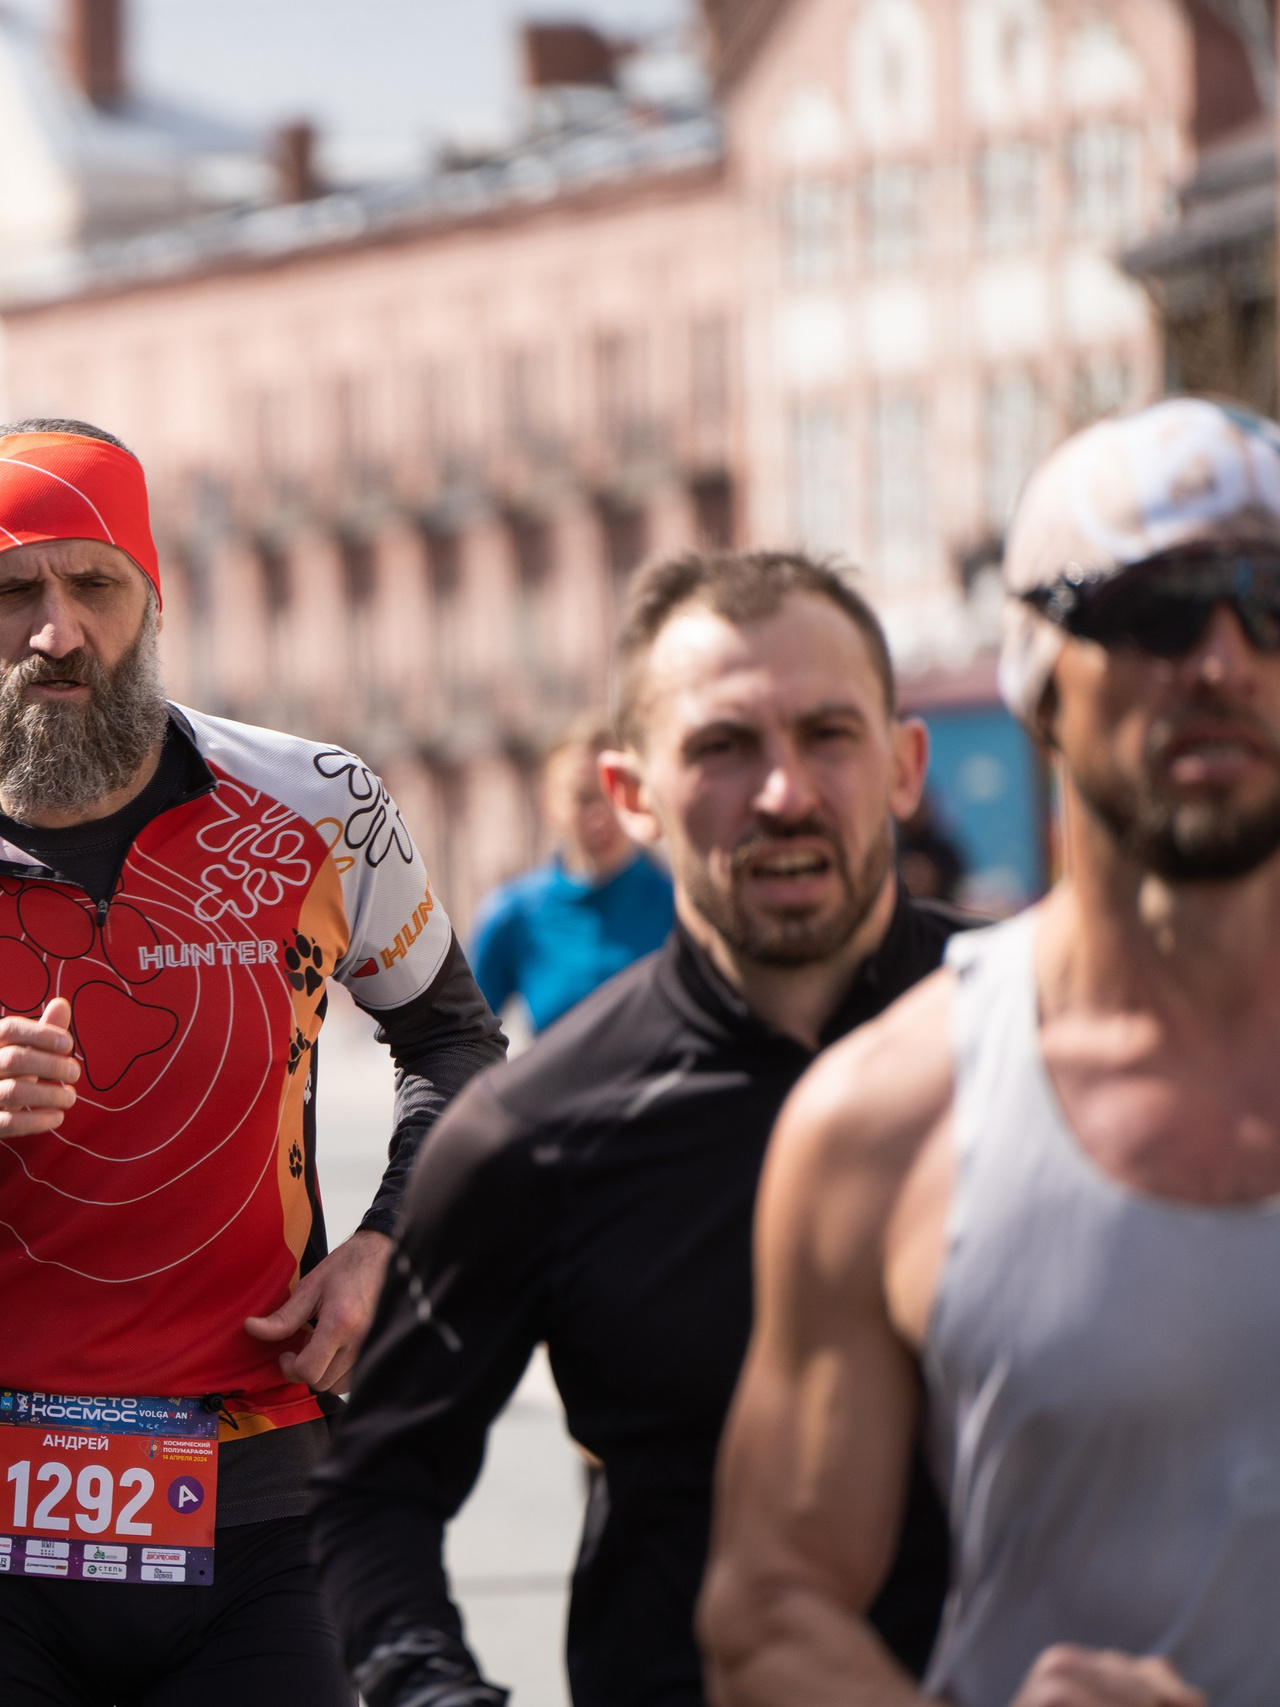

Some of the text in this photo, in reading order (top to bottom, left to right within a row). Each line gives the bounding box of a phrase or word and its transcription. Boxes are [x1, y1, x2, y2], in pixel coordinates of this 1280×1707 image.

[380, 873, 434, 970] HUN
[137, 939, 279, 971] HUNTER
[50, 1394, 138, 1409] ПРОСТО
[31, 1403, 137, 1424] КОСМОС
[139, 1409, 188, 1420] VOLGAMAN
[42, 1434, 110, 1451] АНДРЕЙ
[163, 1440, 211, 1448] КОСМИЧЕСКИЙ
[162, 1447, 214, 1456] ПОЛУМАРАФОН
[6, 1460, 156, 1537] 1292
[98, 1565, 123, 1573] СТЕПЬ
